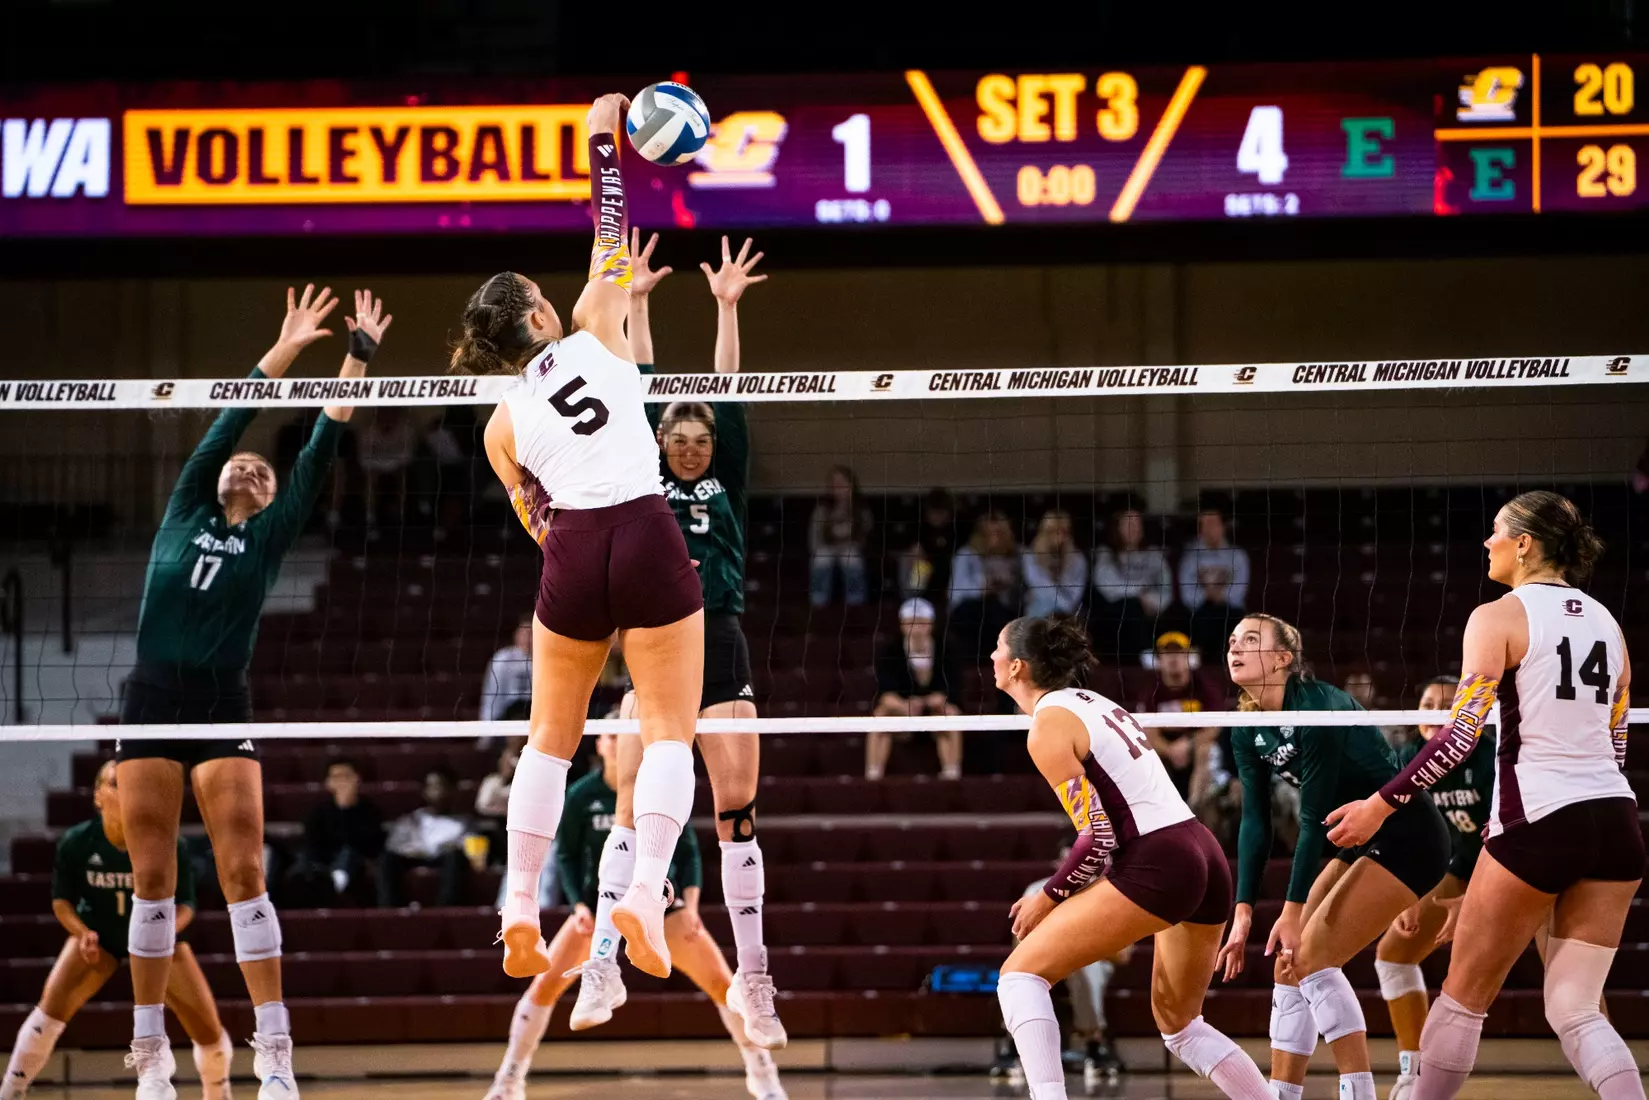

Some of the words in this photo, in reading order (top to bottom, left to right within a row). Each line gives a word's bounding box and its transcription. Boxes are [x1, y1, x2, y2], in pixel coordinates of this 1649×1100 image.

[976, 73, 1087, 144] SET
[1096, 72, 1140, 141] 3
[1574, 62, 1635, 116] 20
[146, 124, 590, 187] VOLLEYBALL
[832, 113, 871, 192] 1
[1237, 105, 1288, 185] 4
[1341, 117, 1395, 178] E
[1576, 144, 1637, 198] 29
[1017, 164, 1096, 206] 0:00
[1469, 147, 1516, 202] E
[600, 167, 624, 248] CHIPPEWAS
[15, 383, 117, 401] VOLLEYBALL
[209, 381, 282, 400] CENTRAL
[288, 380, 373, 400] MICHIGAN
[377, 379, 478, 399] VOLLEYBALL
[648, 376, 732, 395] MICHIGAN
[736, 375, 836, 394] VOLLEYBALL
[928, 372, 1002, 391] CENTRAL
[1007, 369, 1094, 390] MICHIGAN
[1096, 367, 1199, 388] VOLLEYBALL
[1292, 363, 1367, 384] CENTRAL
[1372, 360, 1462, 382] MICHIGAN
[1464, 358, 1570, 380] VOLLEYBALL
[548, 375, 610, 436] 5
[689, 504, 710, 534] 5
[190, 554, 223, 591] 17
[1555, 636, 1611, 705] 14
[1102, 707, 1153, 760] 13
[1410, 709, 1479, 790] CHIPPEWAS
[1066, 809, 1116, 885] CHIPPEWAS
[1446, 809, 1477, 833] 18
[86, 870, 133, 889] EASTE
